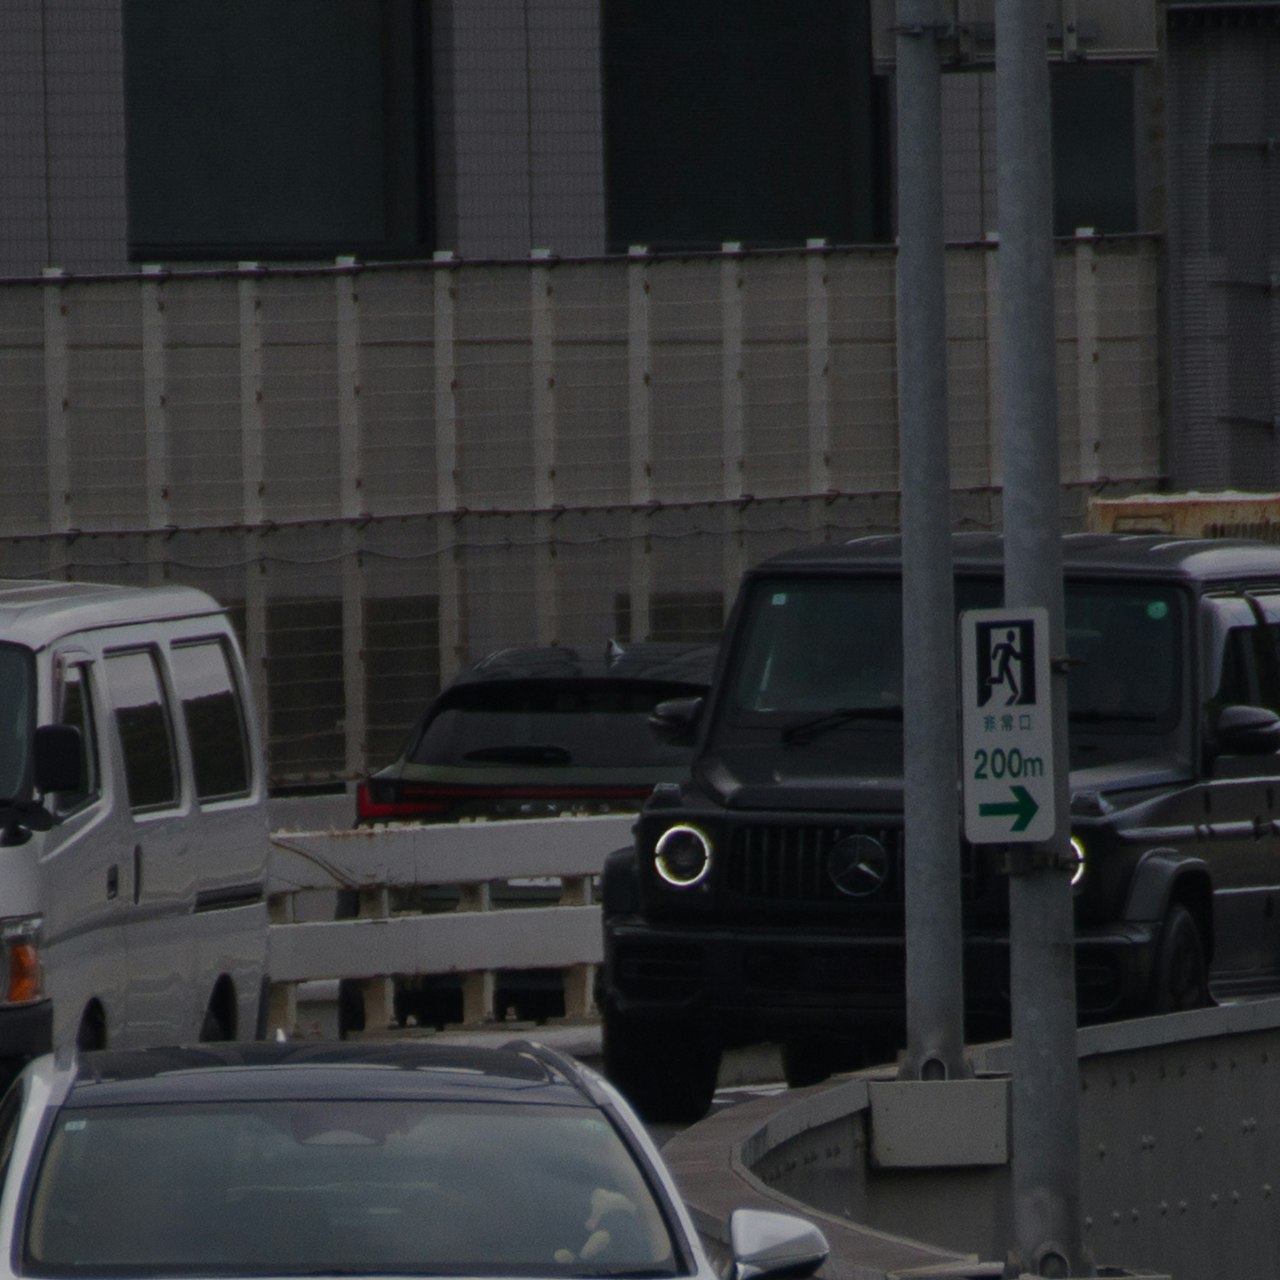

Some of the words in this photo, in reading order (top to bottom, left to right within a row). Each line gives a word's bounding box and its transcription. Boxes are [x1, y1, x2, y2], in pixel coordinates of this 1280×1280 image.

[983, 714, 1032, 731] 非常口
[975, 749, 1043, 779] 200m
